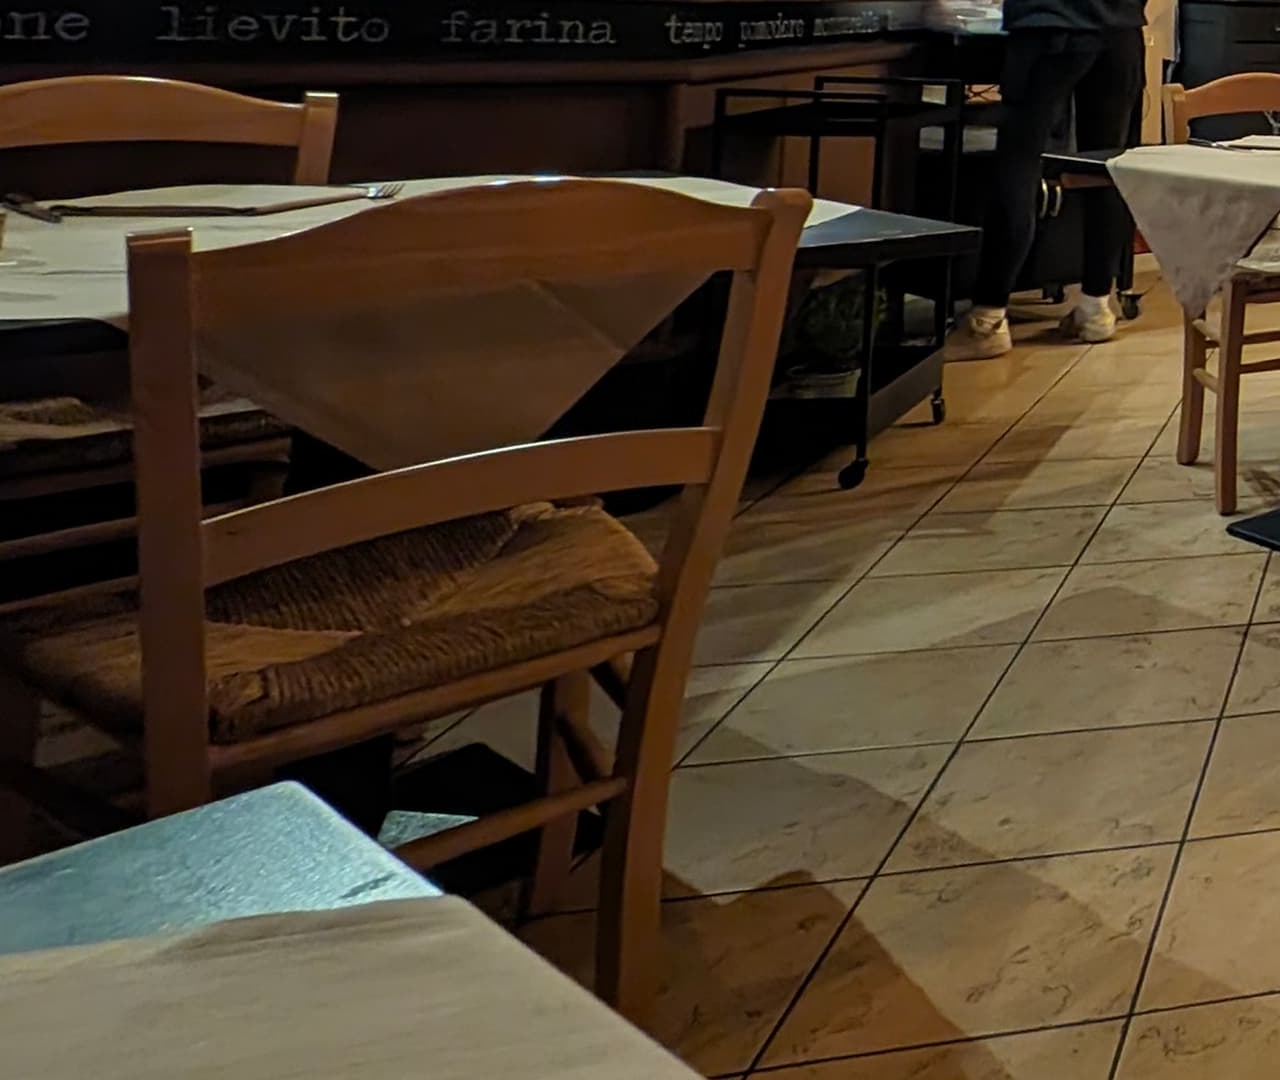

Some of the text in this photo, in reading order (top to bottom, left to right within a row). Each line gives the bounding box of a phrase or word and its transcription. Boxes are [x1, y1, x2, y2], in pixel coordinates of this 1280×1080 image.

[0, 10, 90, 41] ne
[156, 5, 390, 42] lievito
[440, 10, 617, 44] farina
[664, 13, 723, 48] tempo
